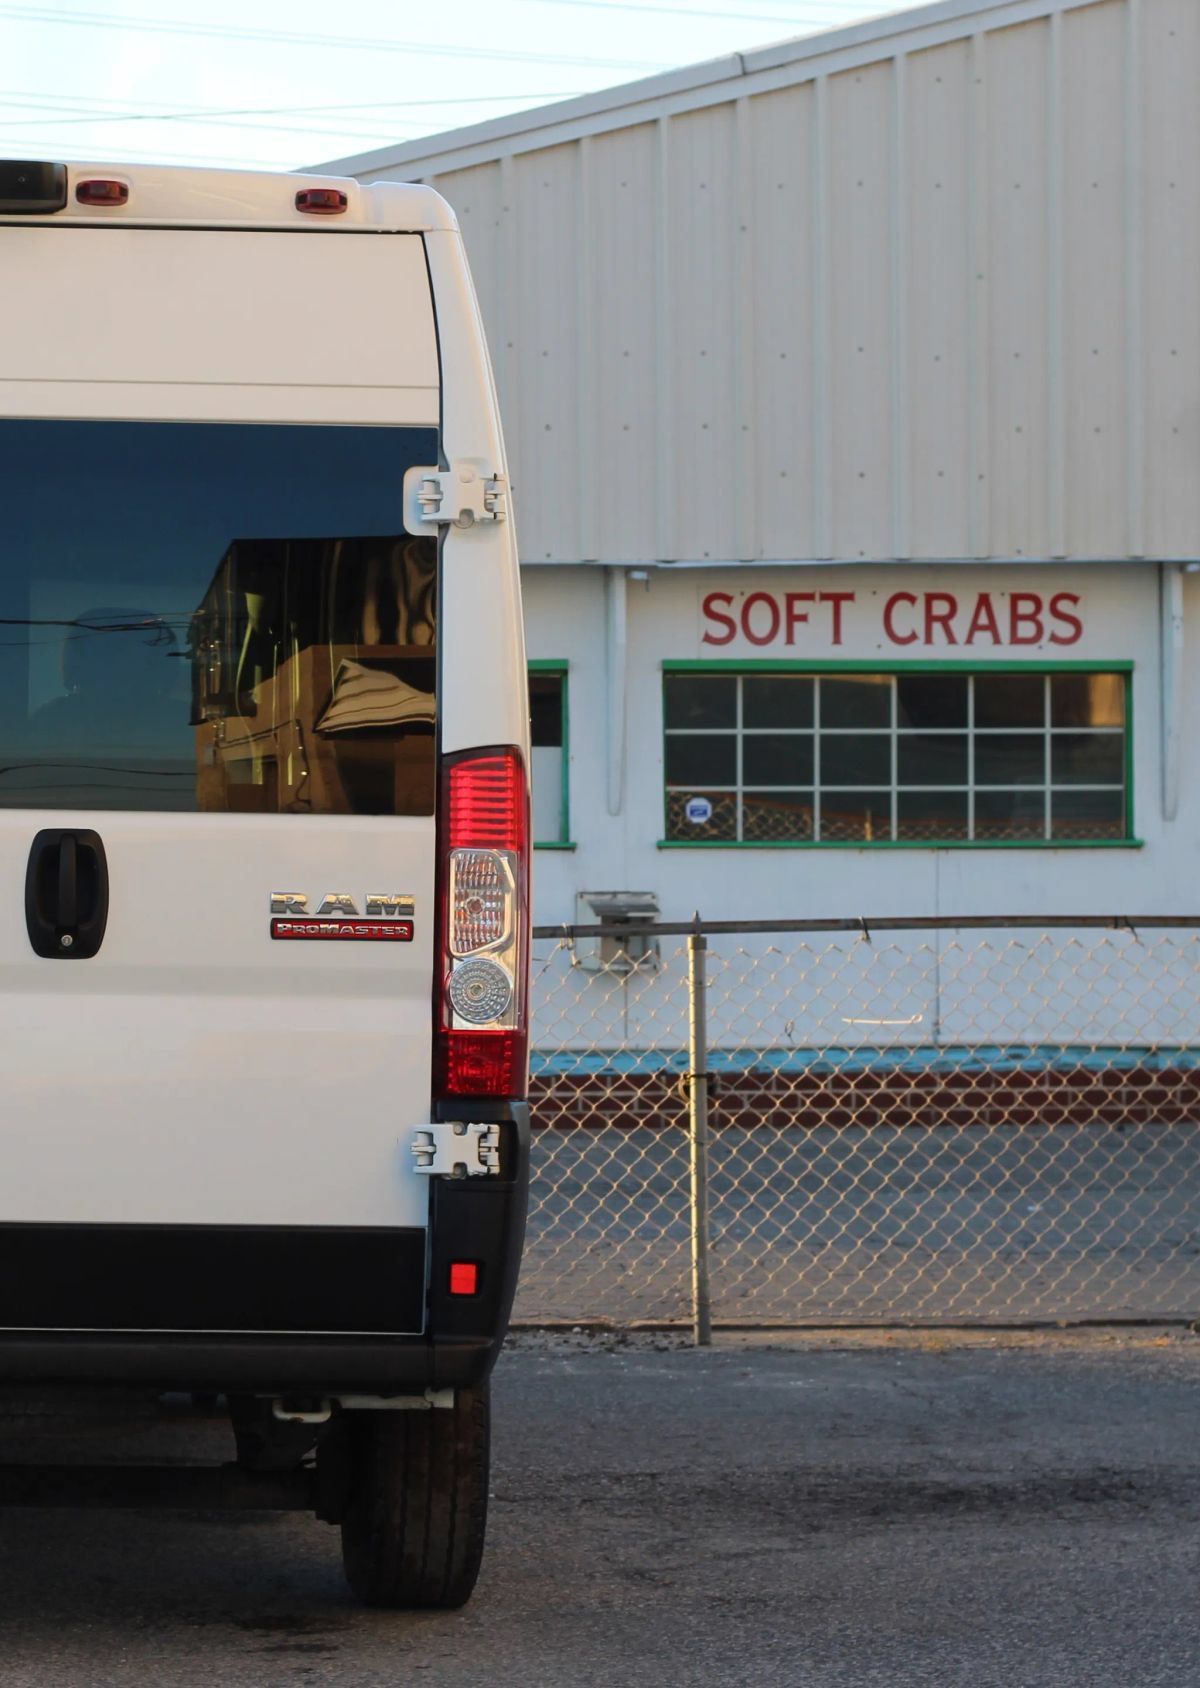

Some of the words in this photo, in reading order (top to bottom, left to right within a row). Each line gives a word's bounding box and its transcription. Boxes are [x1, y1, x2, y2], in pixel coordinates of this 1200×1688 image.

[702, 591, 855, 646] SOFT
[883, 591, 1083, 646] CRABS
[270, 892, 416, 916] RAM
